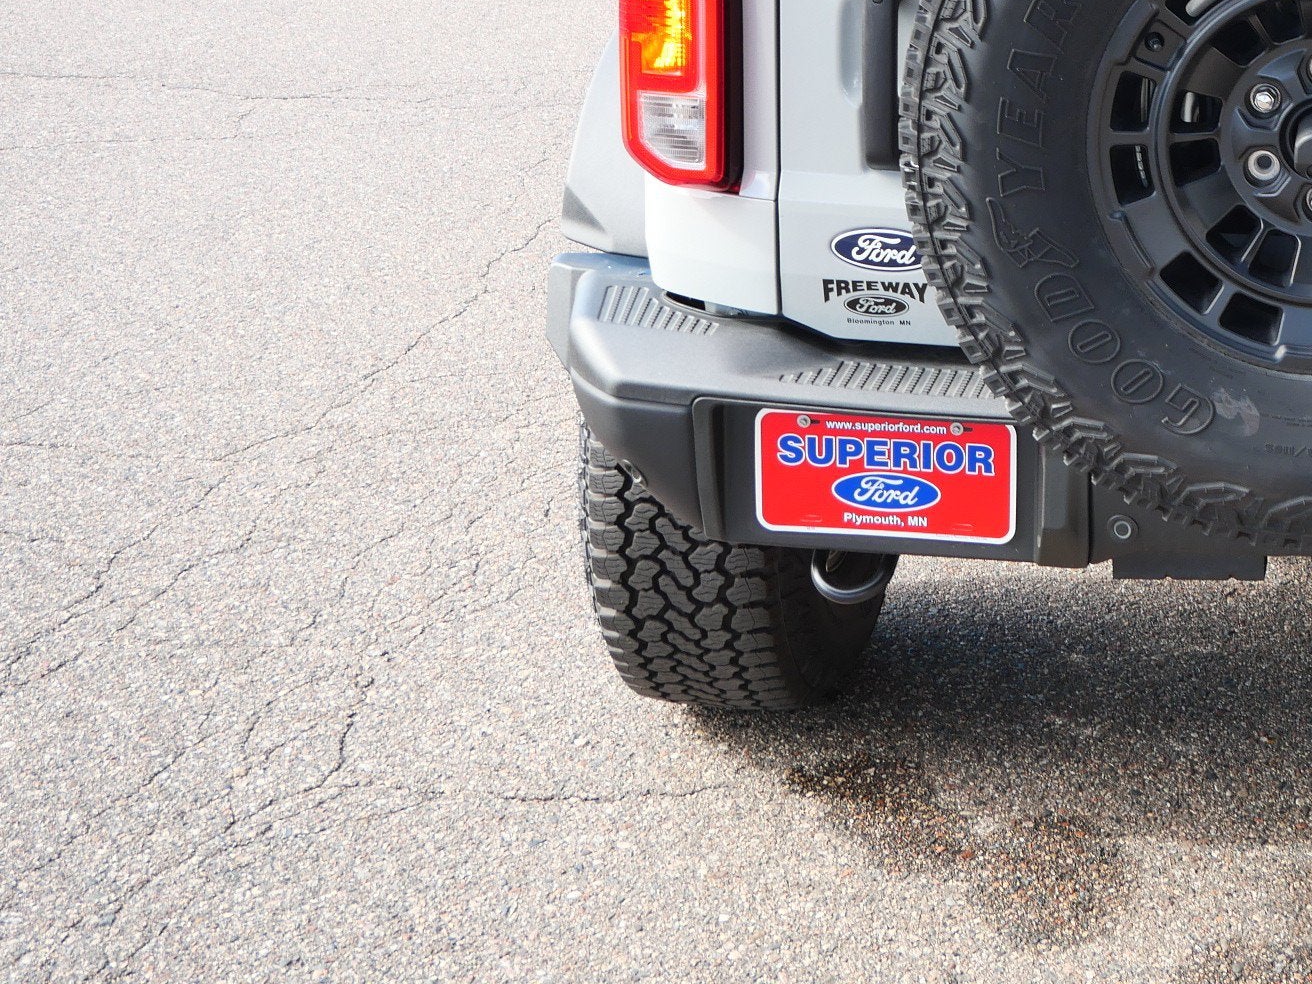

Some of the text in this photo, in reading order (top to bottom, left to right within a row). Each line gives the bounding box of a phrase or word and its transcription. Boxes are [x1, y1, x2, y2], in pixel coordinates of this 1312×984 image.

[851, 234, 917, 265] Ford
[821, 278, 929, 304] FREEWAY
[855, 296, 897, 314] Ford
[846, 316, 895, 326] Bloomington
[825, 419, 947, 435] www.superiorford.com
[777, 432, 996, 477] SUPERIOR
[853, 475, 919, 506] Ford
[842, 511, 928, 528] Plymouth, MN
